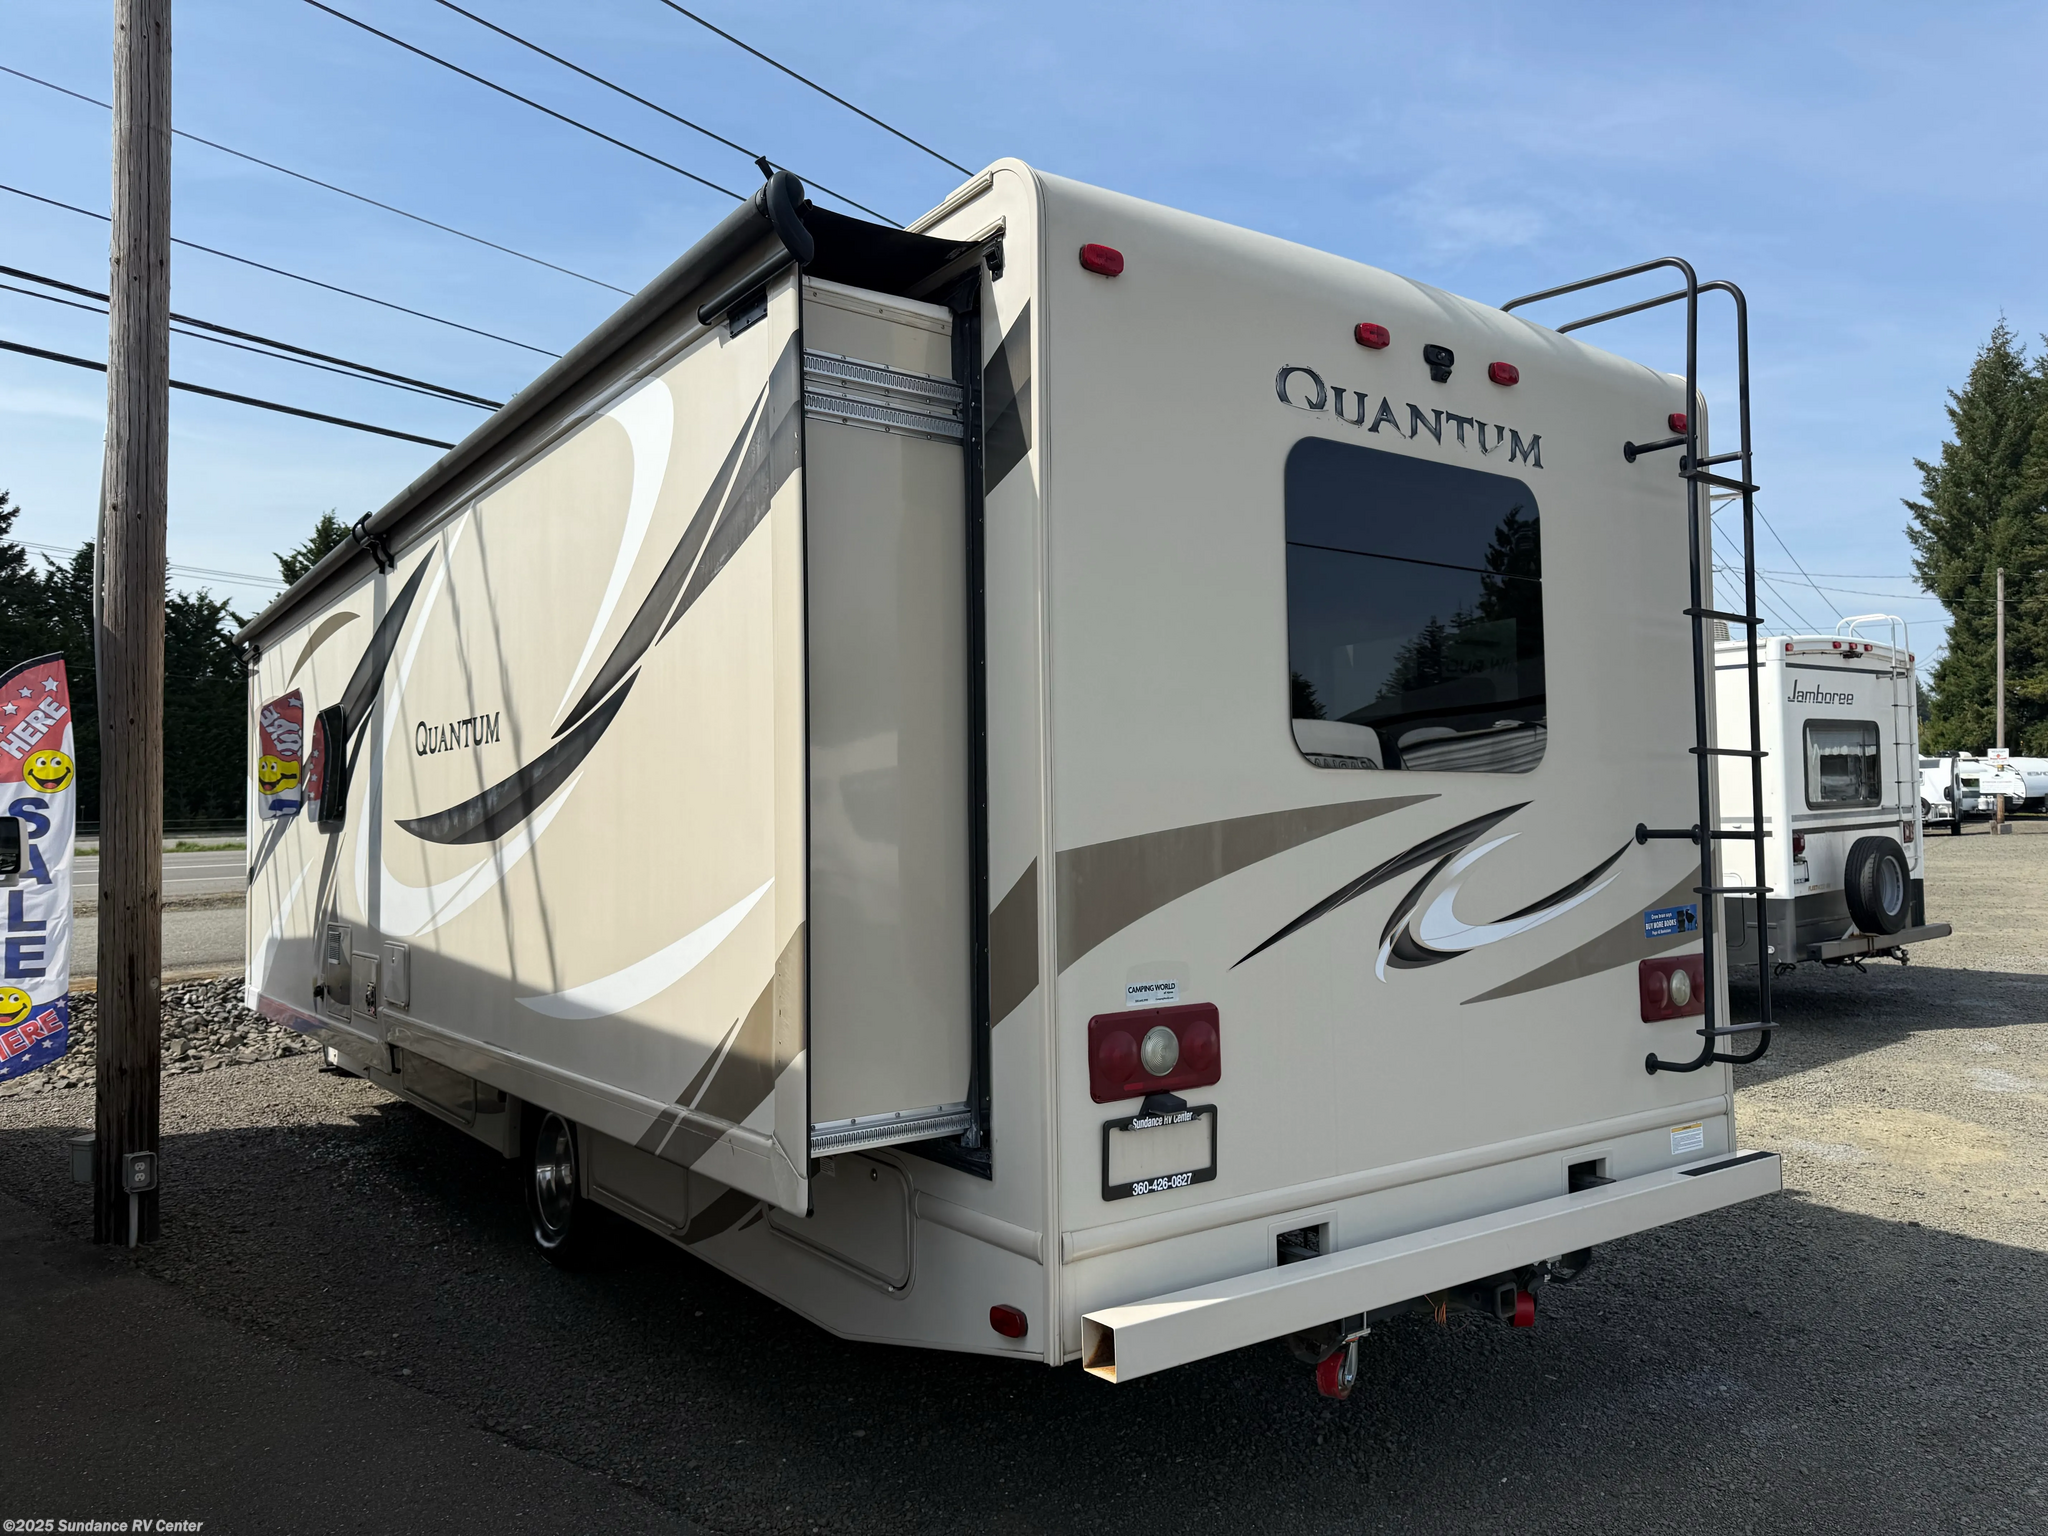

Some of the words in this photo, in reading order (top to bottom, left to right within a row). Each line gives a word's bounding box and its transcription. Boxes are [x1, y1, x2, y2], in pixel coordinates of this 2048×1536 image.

[1275, 364, 1544, 469] QUANTUM
[1787, 679, 1854, 705] Jamboree
[0, 695, 68, 760] HERE
[415, 711, 501, 757] QUANTUM
[1654, 920, 1664, 929] MORE
[1664, 919, 1676, 927] BOOKS
[1127, 984, 1154, 994] CAMPING
[1154, 982, 1176, 991] WORLD
[1132, 1116, 1163, 1129] Sundance
[1163, 1114, 1173, 1125] RV
[1173, 1111, 1194, 1123] Center
[1132, 1172, 1193, 1196] 360-426-0827
